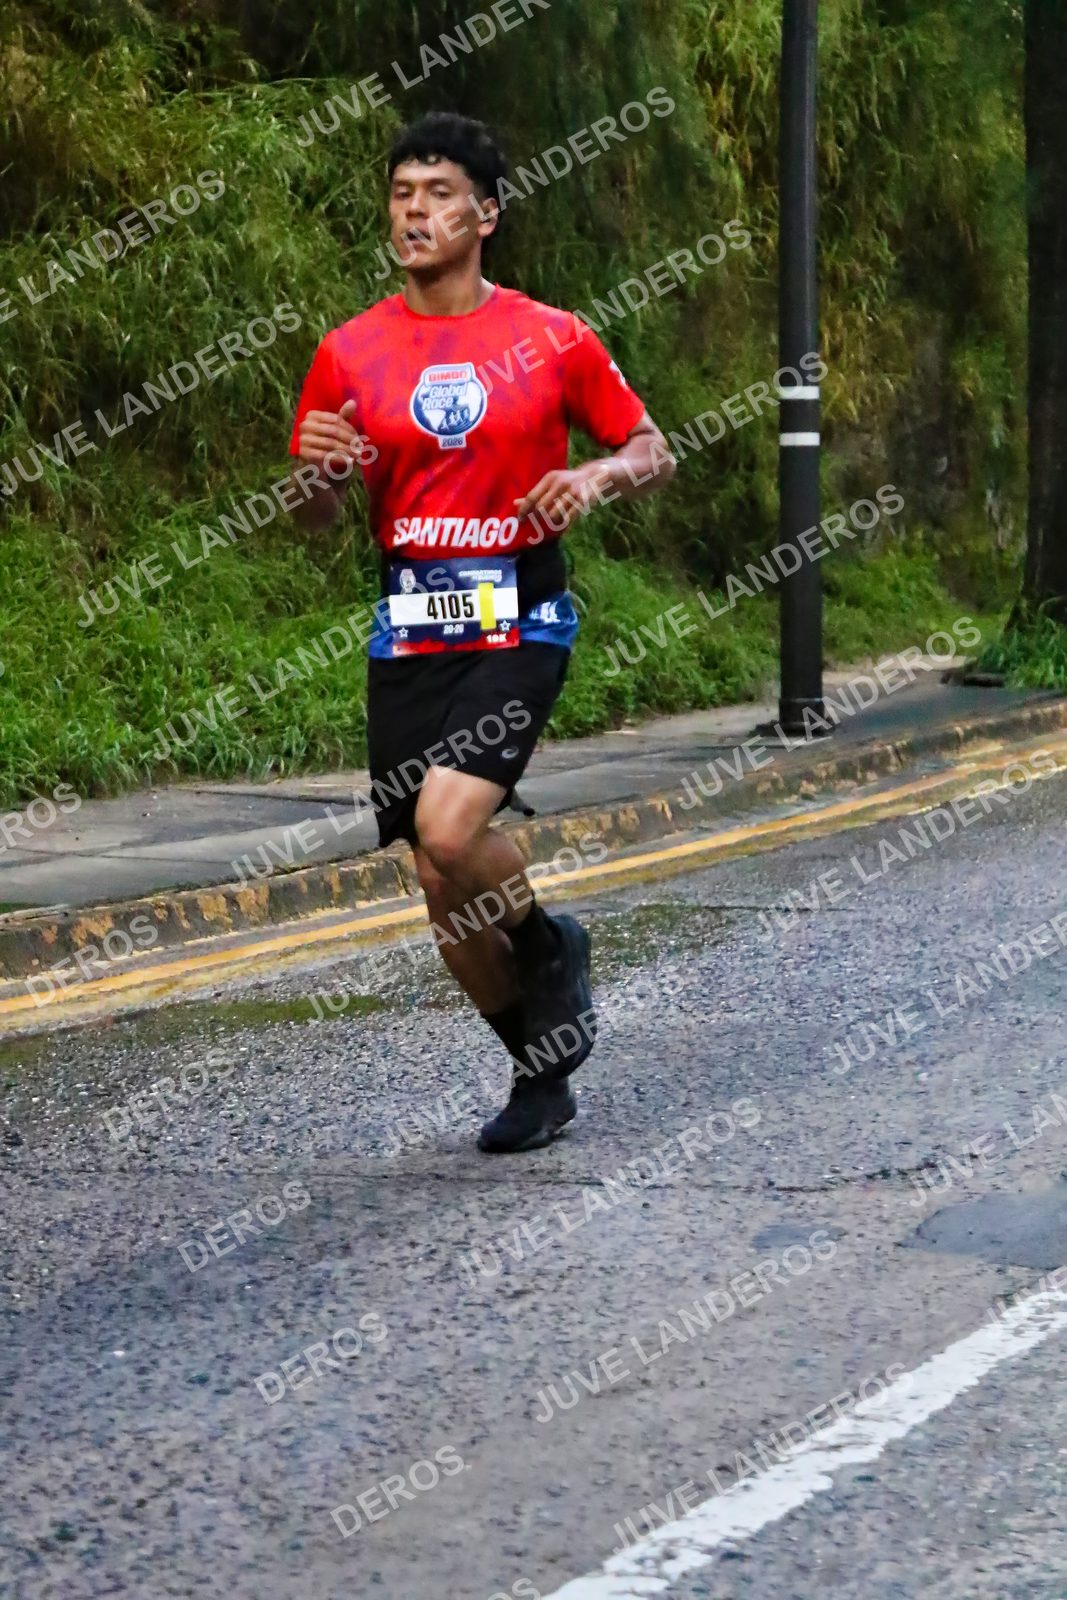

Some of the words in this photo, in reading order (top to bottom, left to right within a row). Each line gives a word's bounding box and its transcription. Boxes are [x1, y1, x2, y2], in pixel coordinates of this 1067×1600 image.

[428, 370, 468, 382] BIMBO
[429, 381, 468, 399] Global
[421, 396, 453, 411] Race
[441, 436, 464, 448] 2026
[393, 516, 519, 548] SANTIAGO
[426, 594, 475, 620] 4105
[486, 633, 507, 643] 10K
